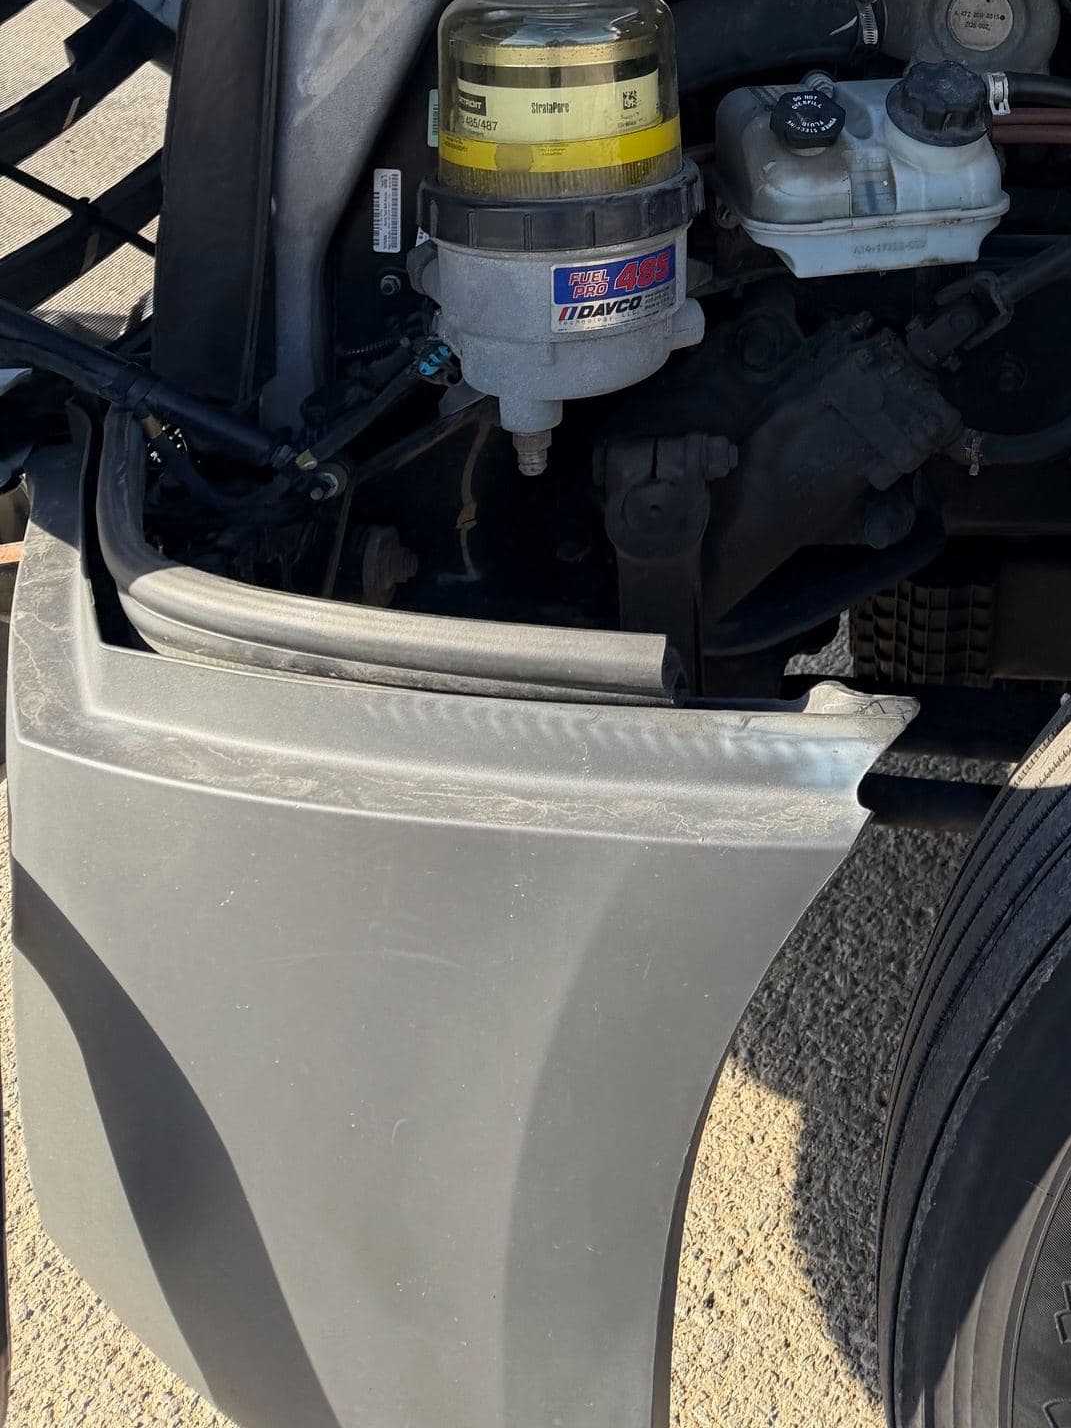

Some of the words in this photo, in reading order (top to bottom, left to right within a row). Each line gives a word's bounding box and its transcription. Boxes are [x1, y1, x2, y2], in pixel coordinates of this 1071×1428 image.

[458, 93, 484, 110] ETROIT
[531, 101, 570, 114] StrataPore
[568, 269, 610, 286] FUEL
[613, 252, 671, 292] 485
[572, 281, 609, 299] PRO
[576, 295, 643, 320] DAVCO
